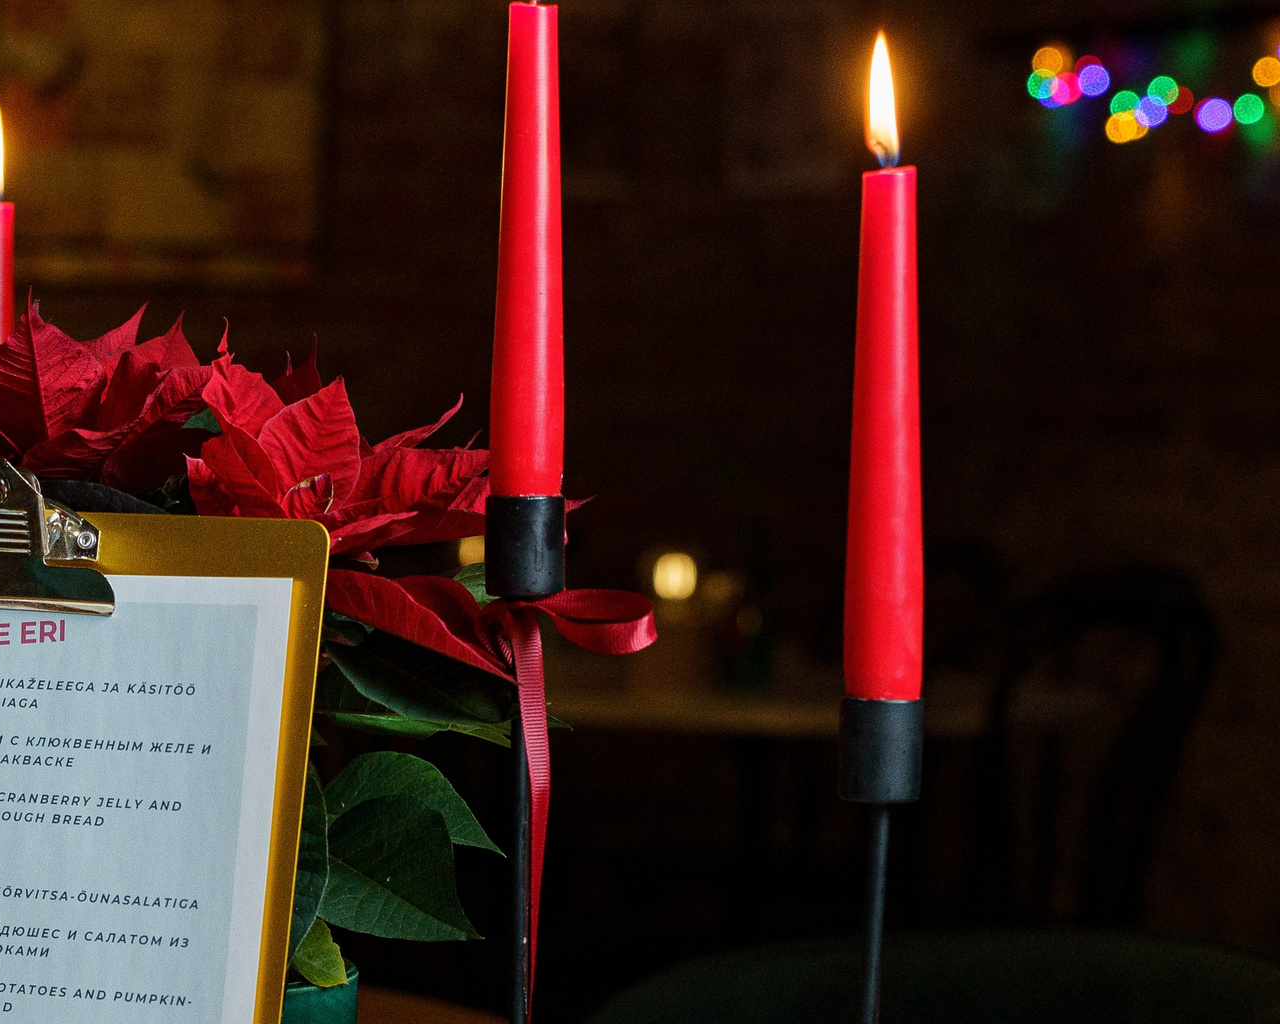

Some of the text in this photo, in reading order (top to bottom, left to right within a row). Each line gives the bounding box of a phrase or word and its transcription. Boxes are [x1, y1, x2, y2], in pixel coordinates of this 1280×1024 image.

[20, 619, 66, 645] ERI
[101, 682, 120, 694] JA
[126, 681, 196, 697] KÄSITÖÖ
[25, 736, 144, 752] КЛЮКВЕННЫМ
[149, 741, 195, 755] ЖЕЛЕ
[200, 744, 212, 755] И
[96, 796, 144, 810] JELLY
[148, 799, 182, 812] AND
[51, 813, 105, 827] BREAD
[66, 929, 78, 941] И
[83, 930, 163, 947] САЛАТОМ
[169, 936, 190, 949] ИЗ
[72, 988, 107, 1001] AND
[113, 990, 192, 1007] PUMPKIN-
